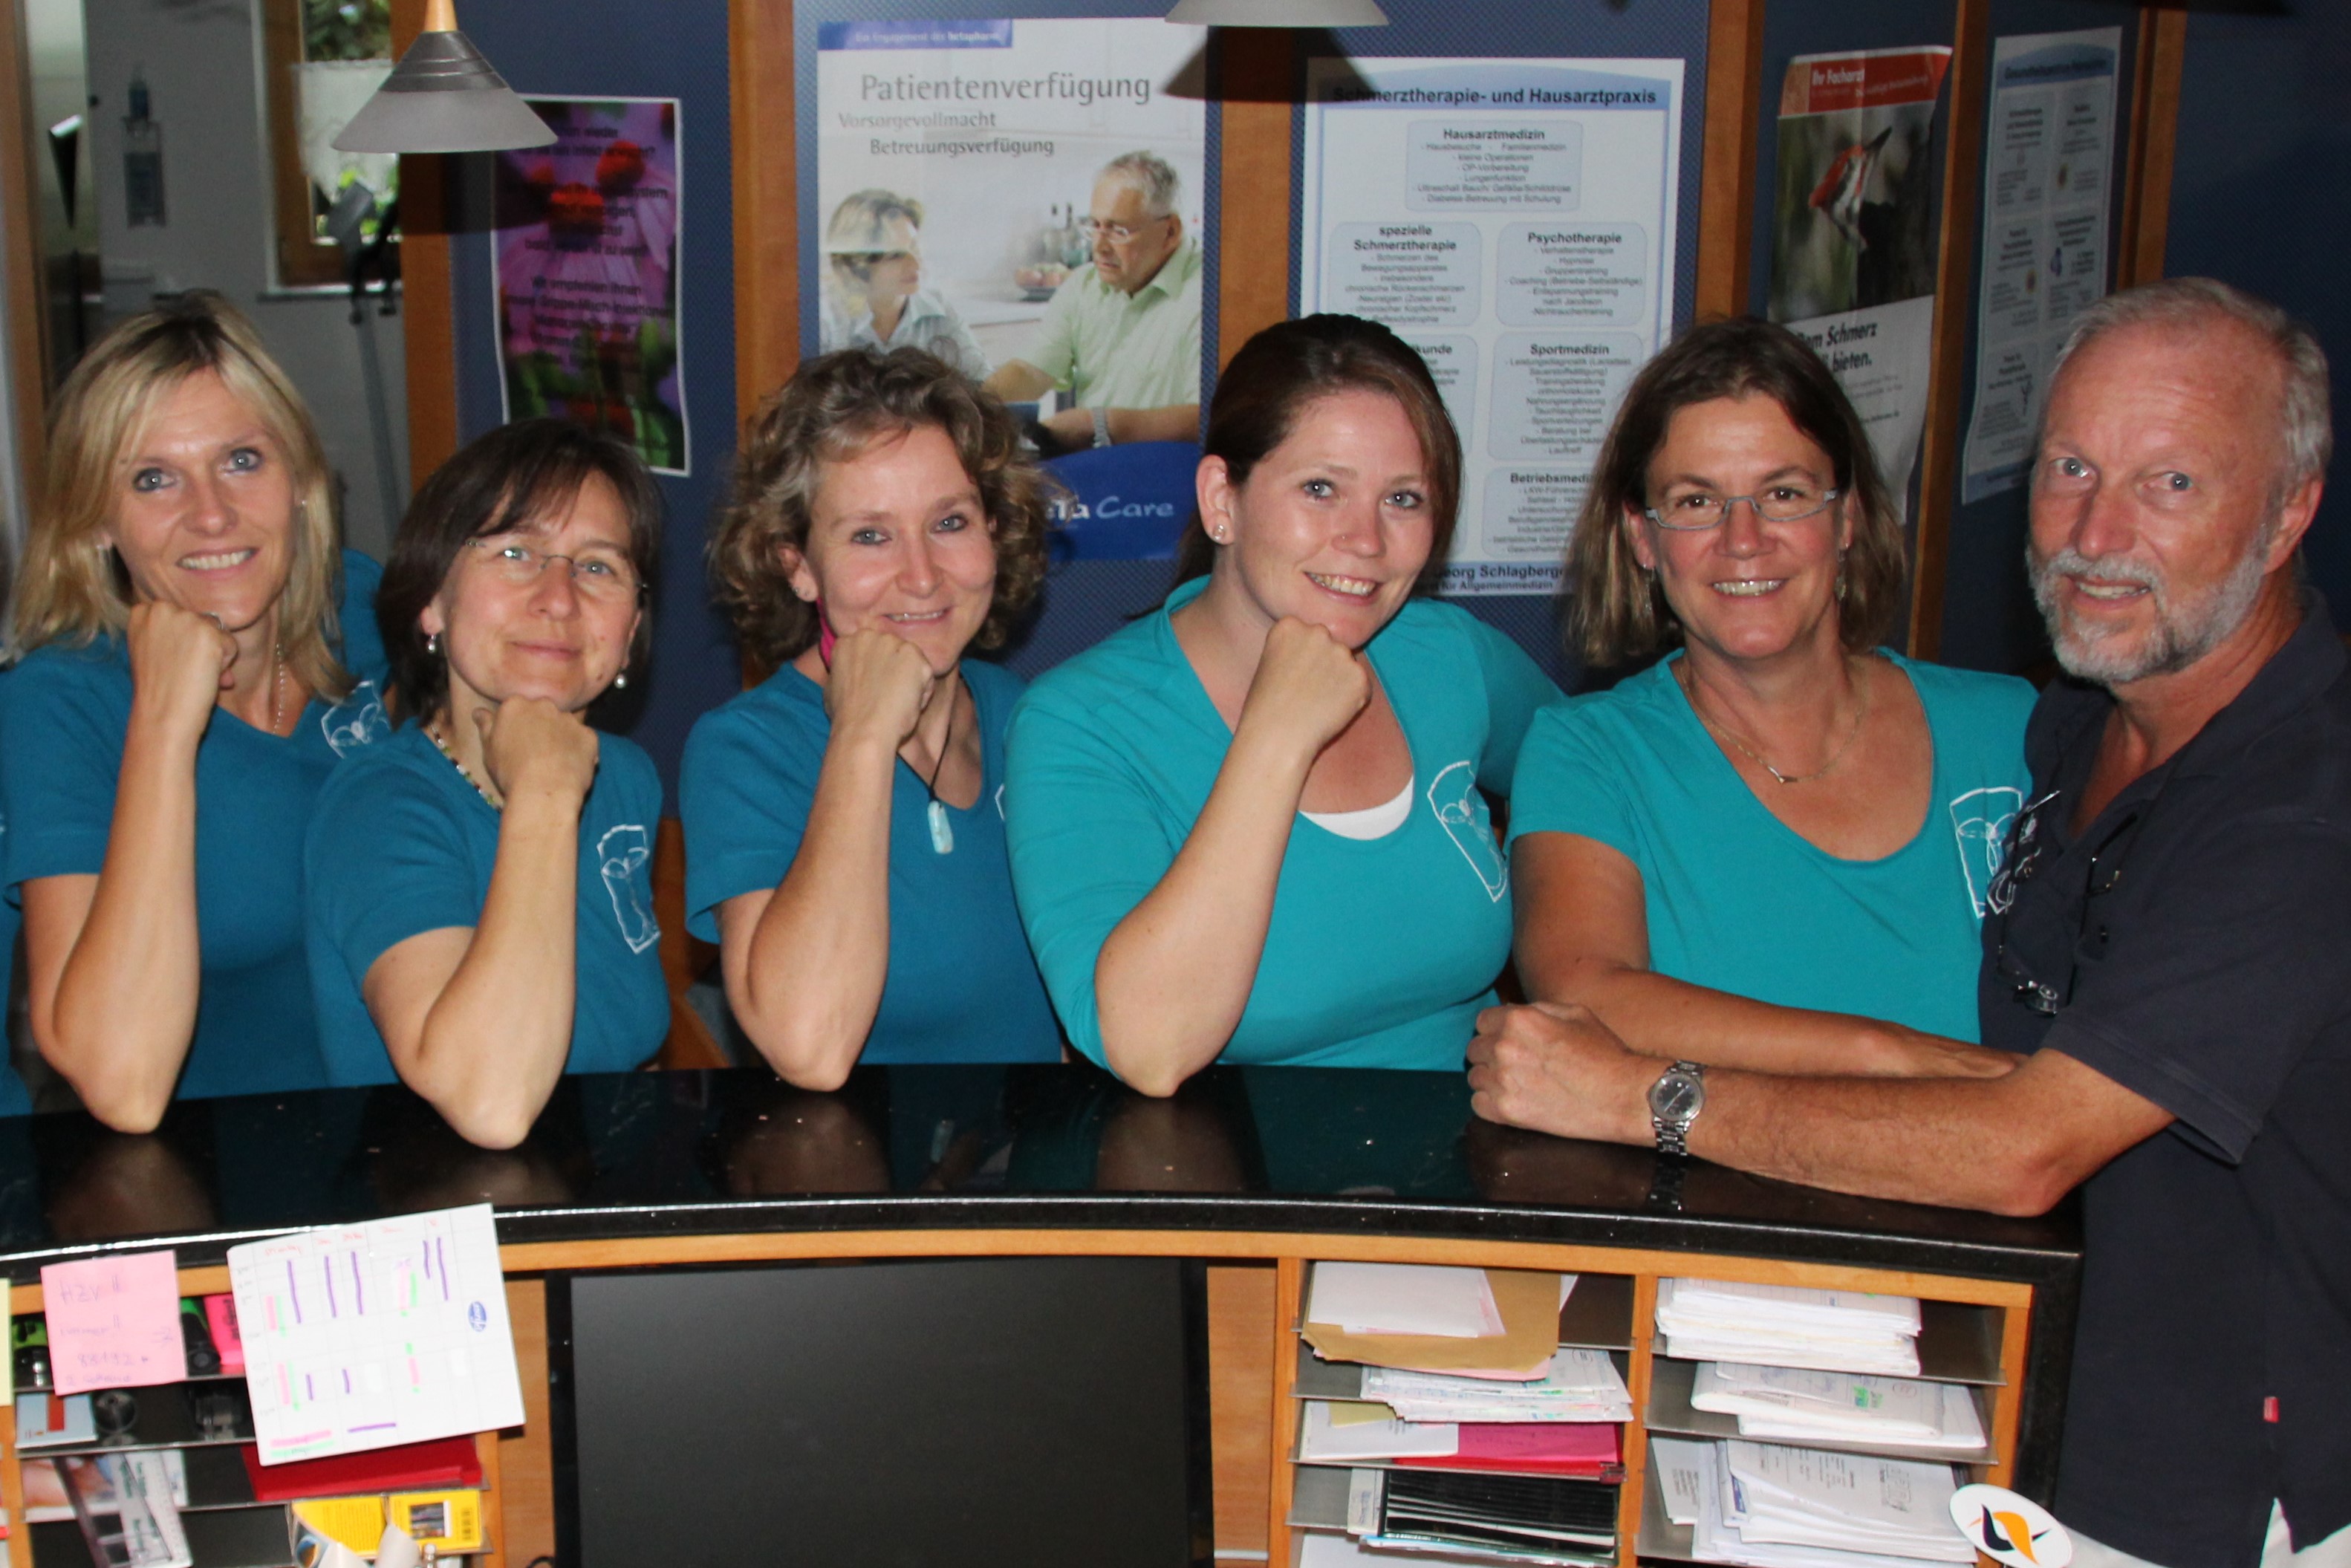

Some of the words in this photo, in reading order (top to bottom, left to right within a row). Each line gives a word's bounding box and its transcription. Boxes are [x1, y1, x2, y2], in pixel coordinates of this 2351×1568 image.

[861, 72, 1151, 105] Patientenverfügung
[1492, 88, 1524, 104] und
[1529, 88, 1657, 106] Hausarztpraxis
[839, 111, 997, 130] Vorsorgevollmacht
[1443, 128, 1546, 140] Hausarztmedizin
[869, 137, 1054, 157] Betreuungsverfügung
[1379, 224, 1433, 238] spezielle
[1527, 232, 1623, 246] Psychotherapie
[1353, 238, 1457, 253] Schmerztherapie
[1827, 322, 1879, 348] Schmerz
[1529, 343, 1610, 357] Sportmedizin
[1096, 495, 1174, 520] Care
[1460, 579, 1553, 593] Allgemeinmedizin
